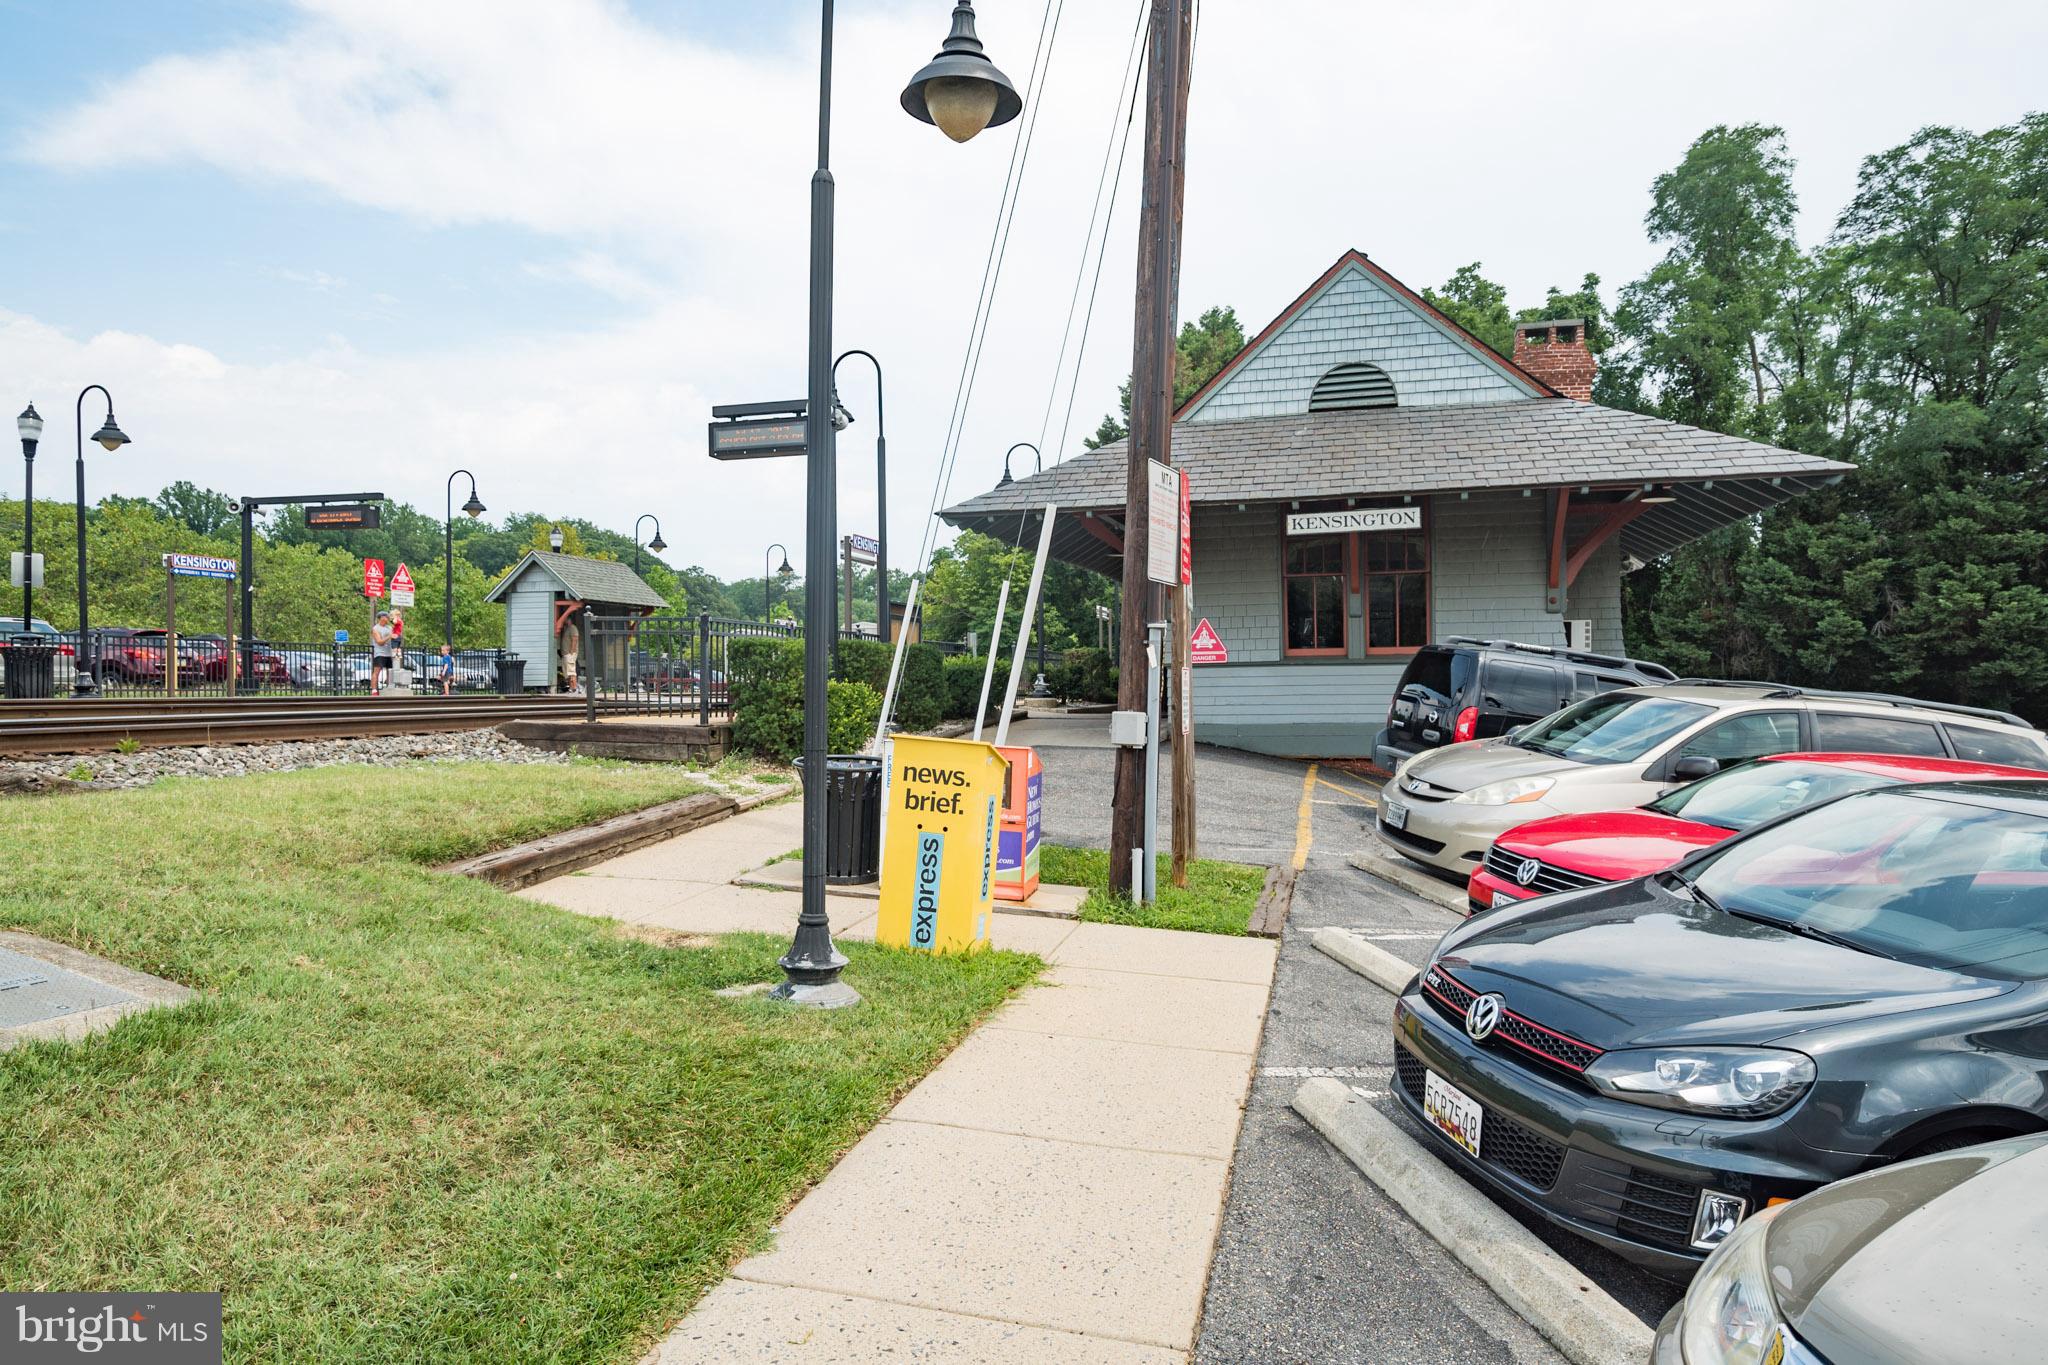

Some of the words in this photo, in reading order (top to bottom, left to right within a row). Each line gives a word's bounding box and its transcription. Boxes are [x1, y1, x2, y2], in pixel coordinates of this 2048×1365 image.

[1291, 511, 1416, 530] KENSINGTON
[173, 554, 235, 571] KENSINGTON
[903, 765, 970, 787] news.
[905, 788, 964, 815] brief.
[982, 800, 994, 897] express
[915, 838, 939, 944] express
